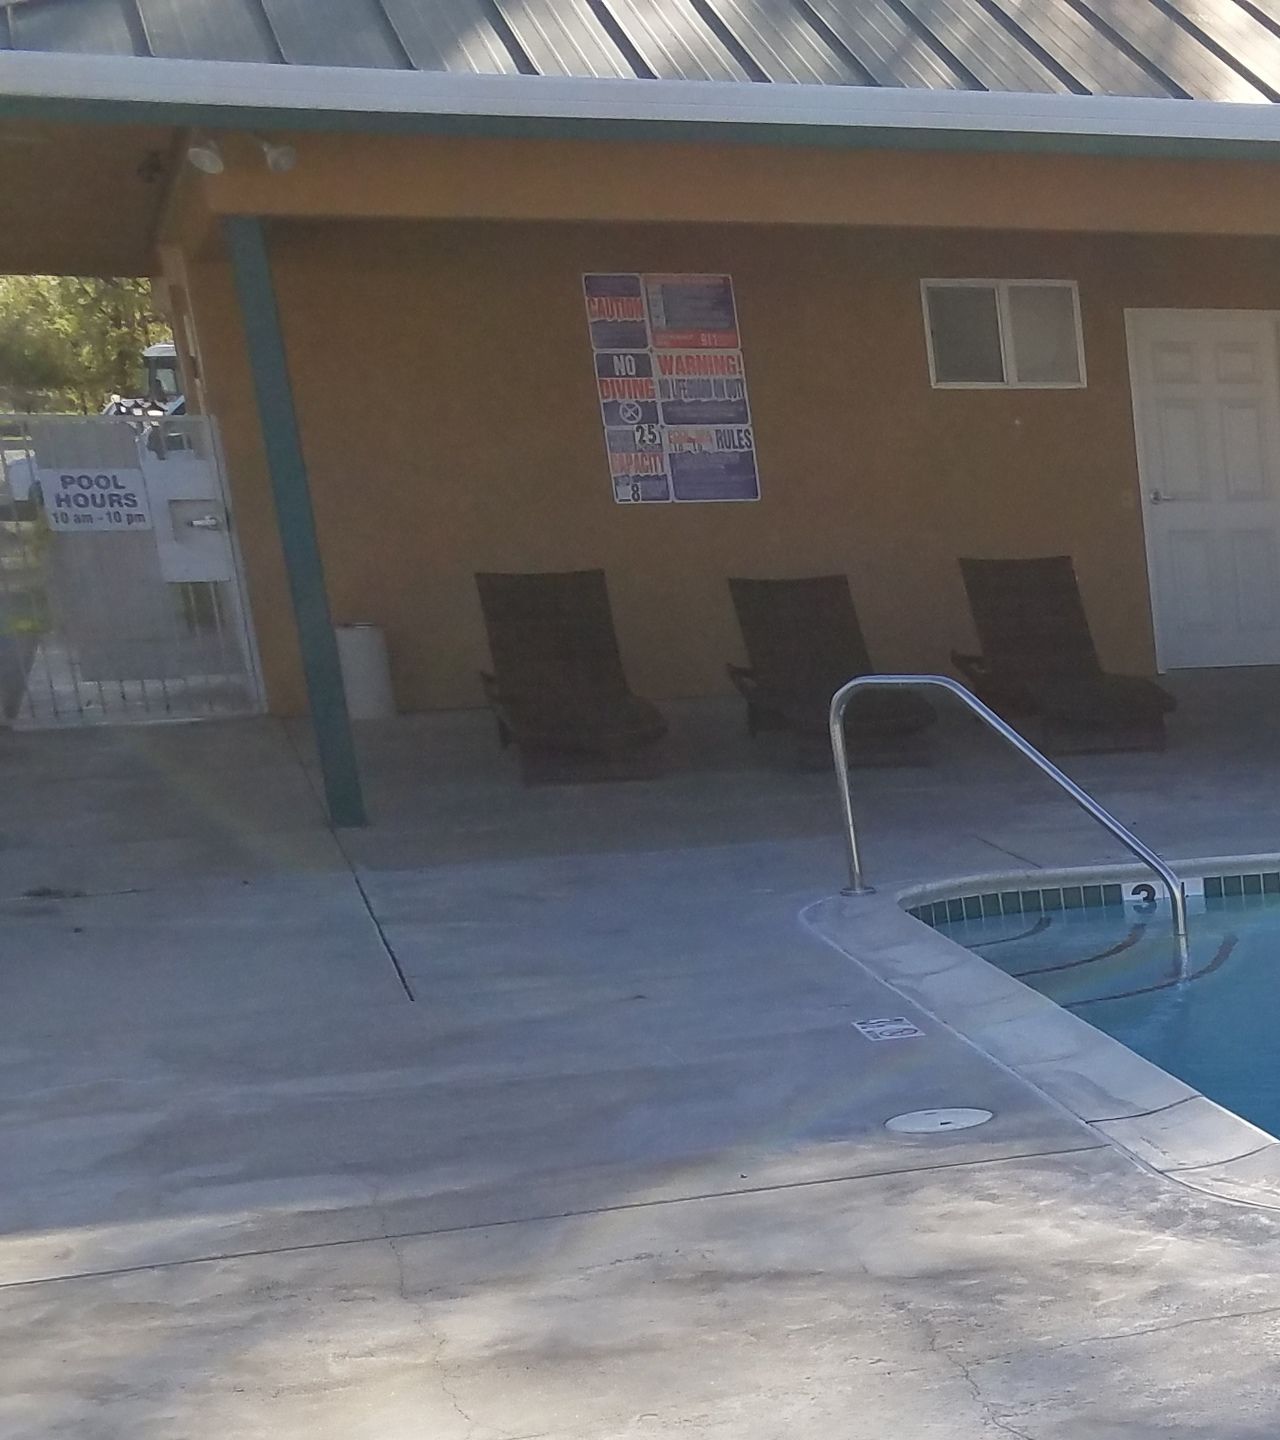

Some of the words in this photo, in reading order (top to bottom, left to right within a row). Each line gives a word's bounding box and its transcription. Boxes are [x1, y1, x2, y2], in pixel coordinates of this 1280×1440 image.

[612, 354, 636, 376] NO
[658, 353, 743, 376] WARNING!
[599, 379, 658, 400] DIVING
[635, 424, 657, 444] 25
[714, 428, 753, 450] RULES
[60, 475, 126, 490] POOL
[54, 493, 138, 508] HOURS
[52, 512, 69, 524] 10
[73, 514, 93, 524] am
[105, 511, 122, 523] 10
[126, 513, 146, 525] pm
